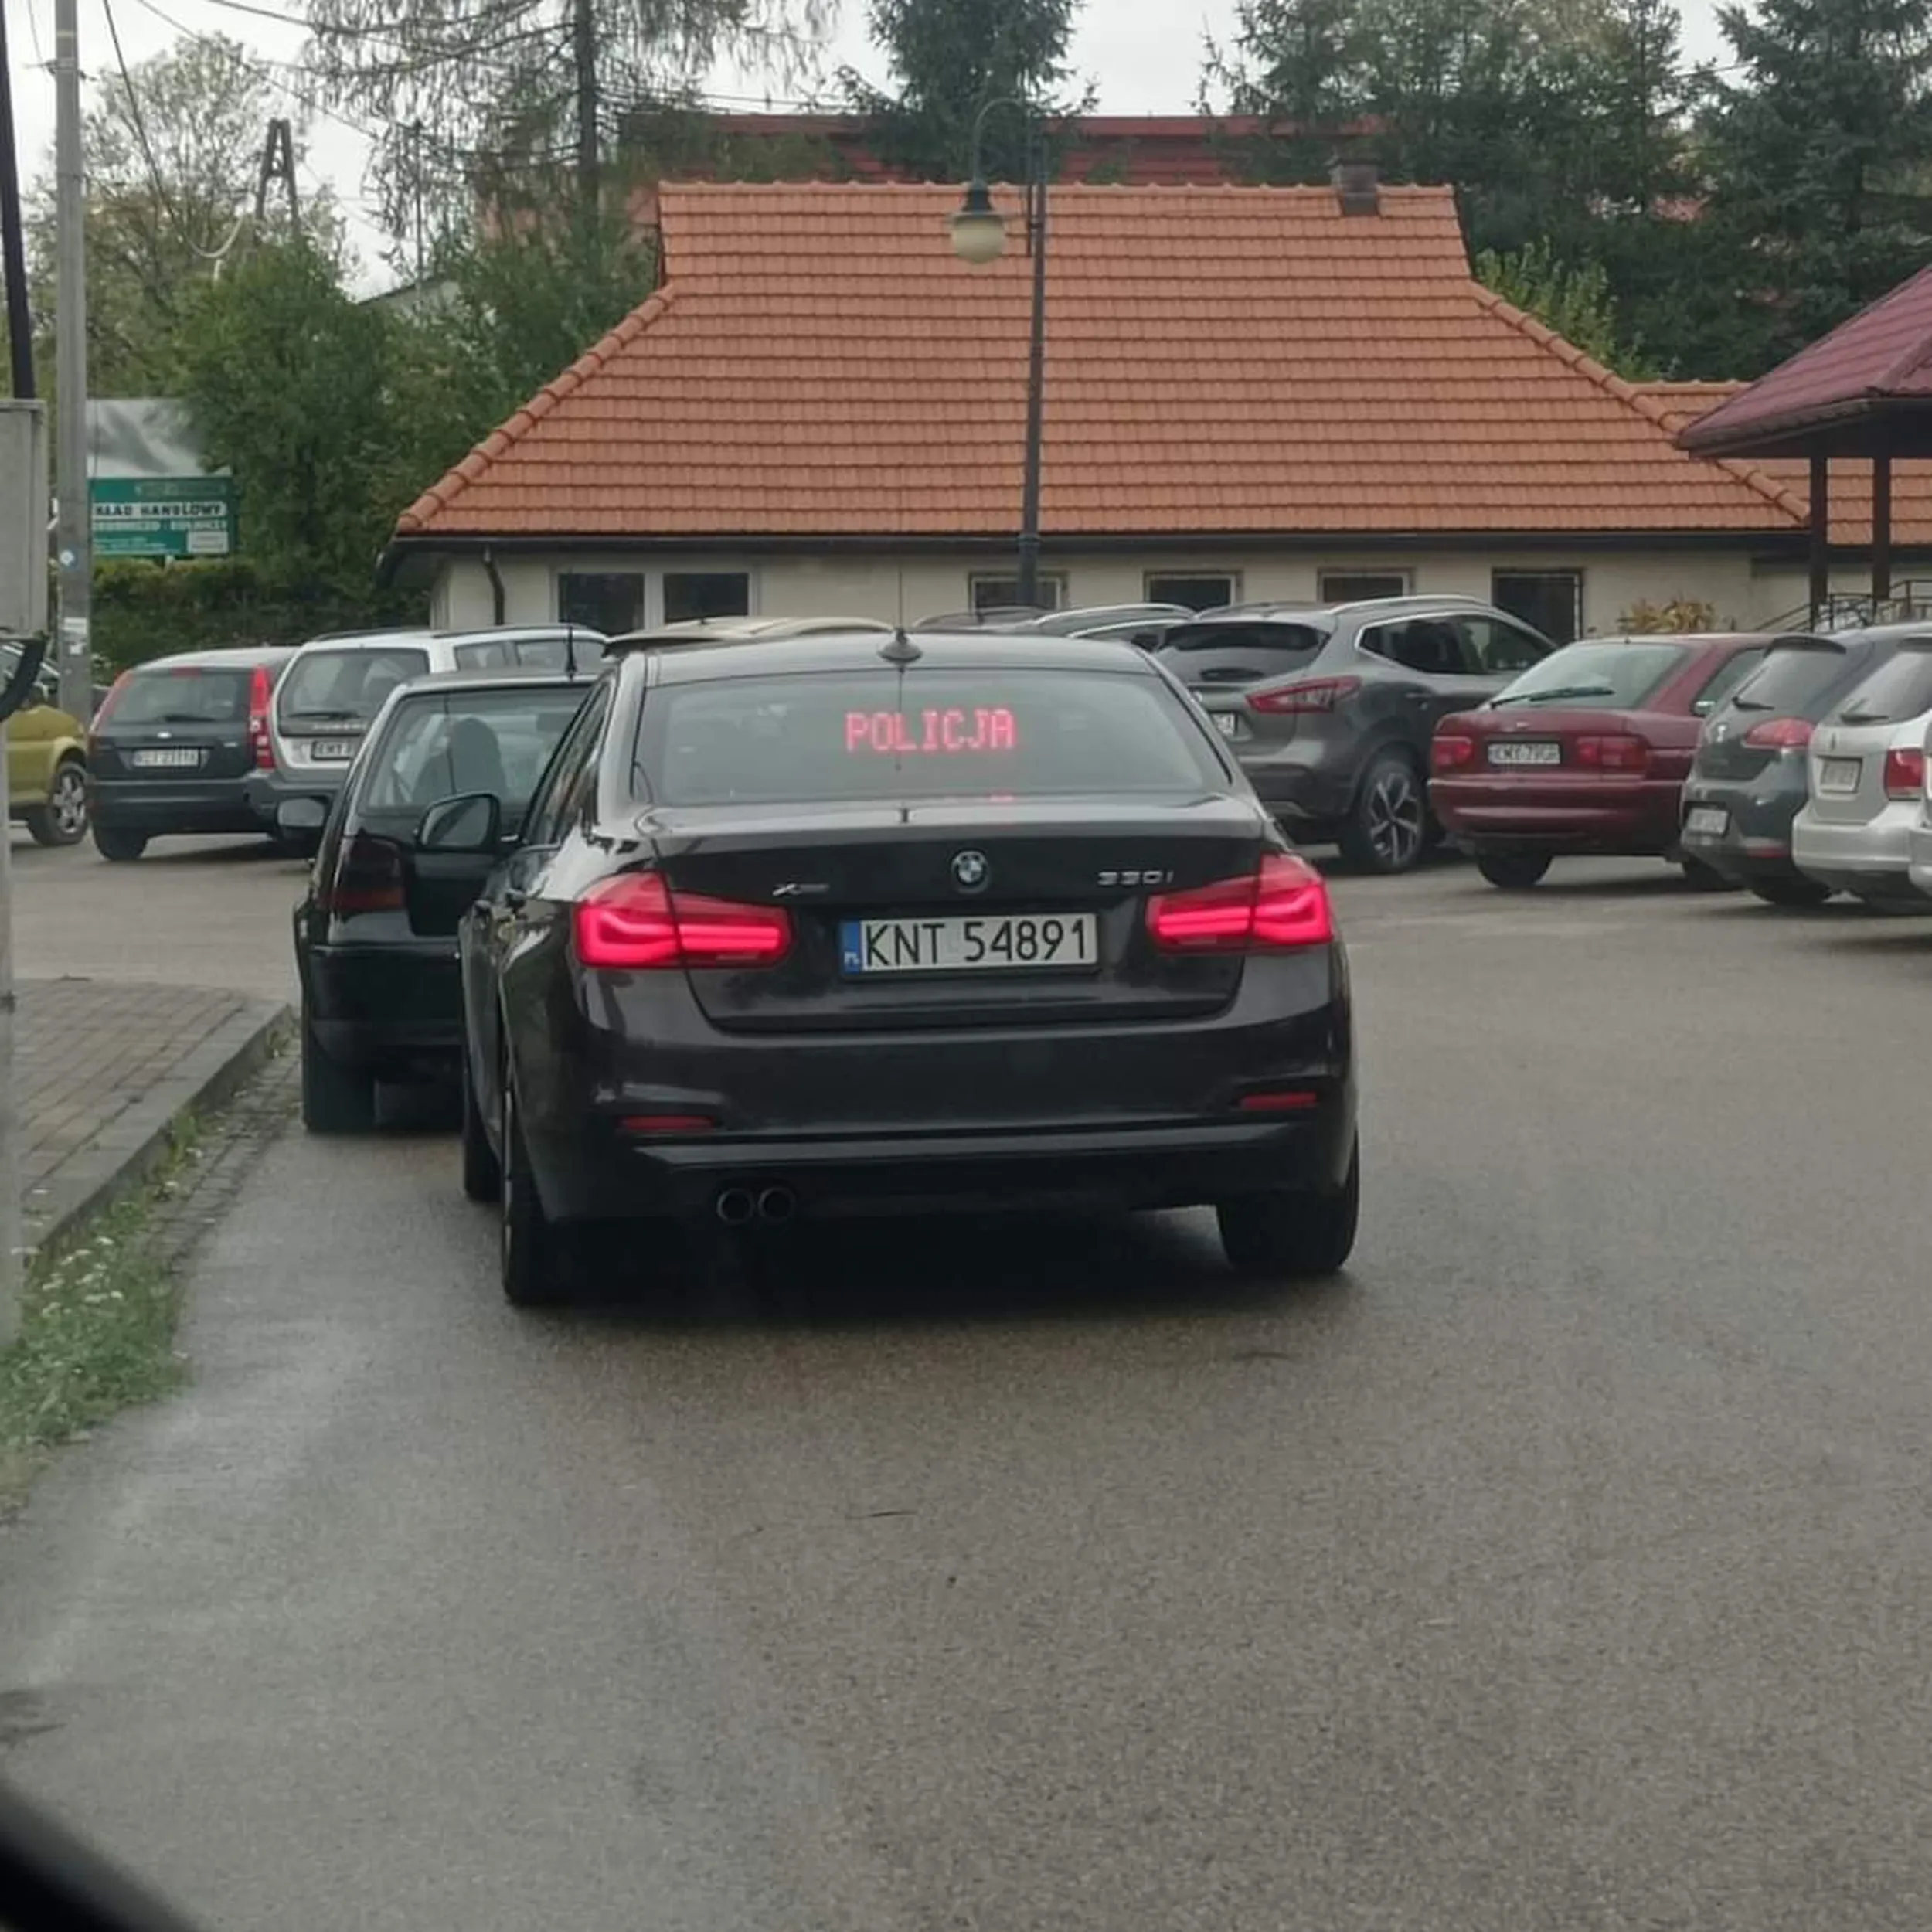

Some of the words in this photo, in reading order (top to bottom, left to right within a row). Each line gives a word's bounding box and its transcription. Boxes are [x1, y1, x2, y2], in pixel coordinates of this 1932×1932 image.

[845, 709, 1016, 751] POLICJA
[866, 923, 945, 965] KNT
[964, 918, 1086, 962] 54891
